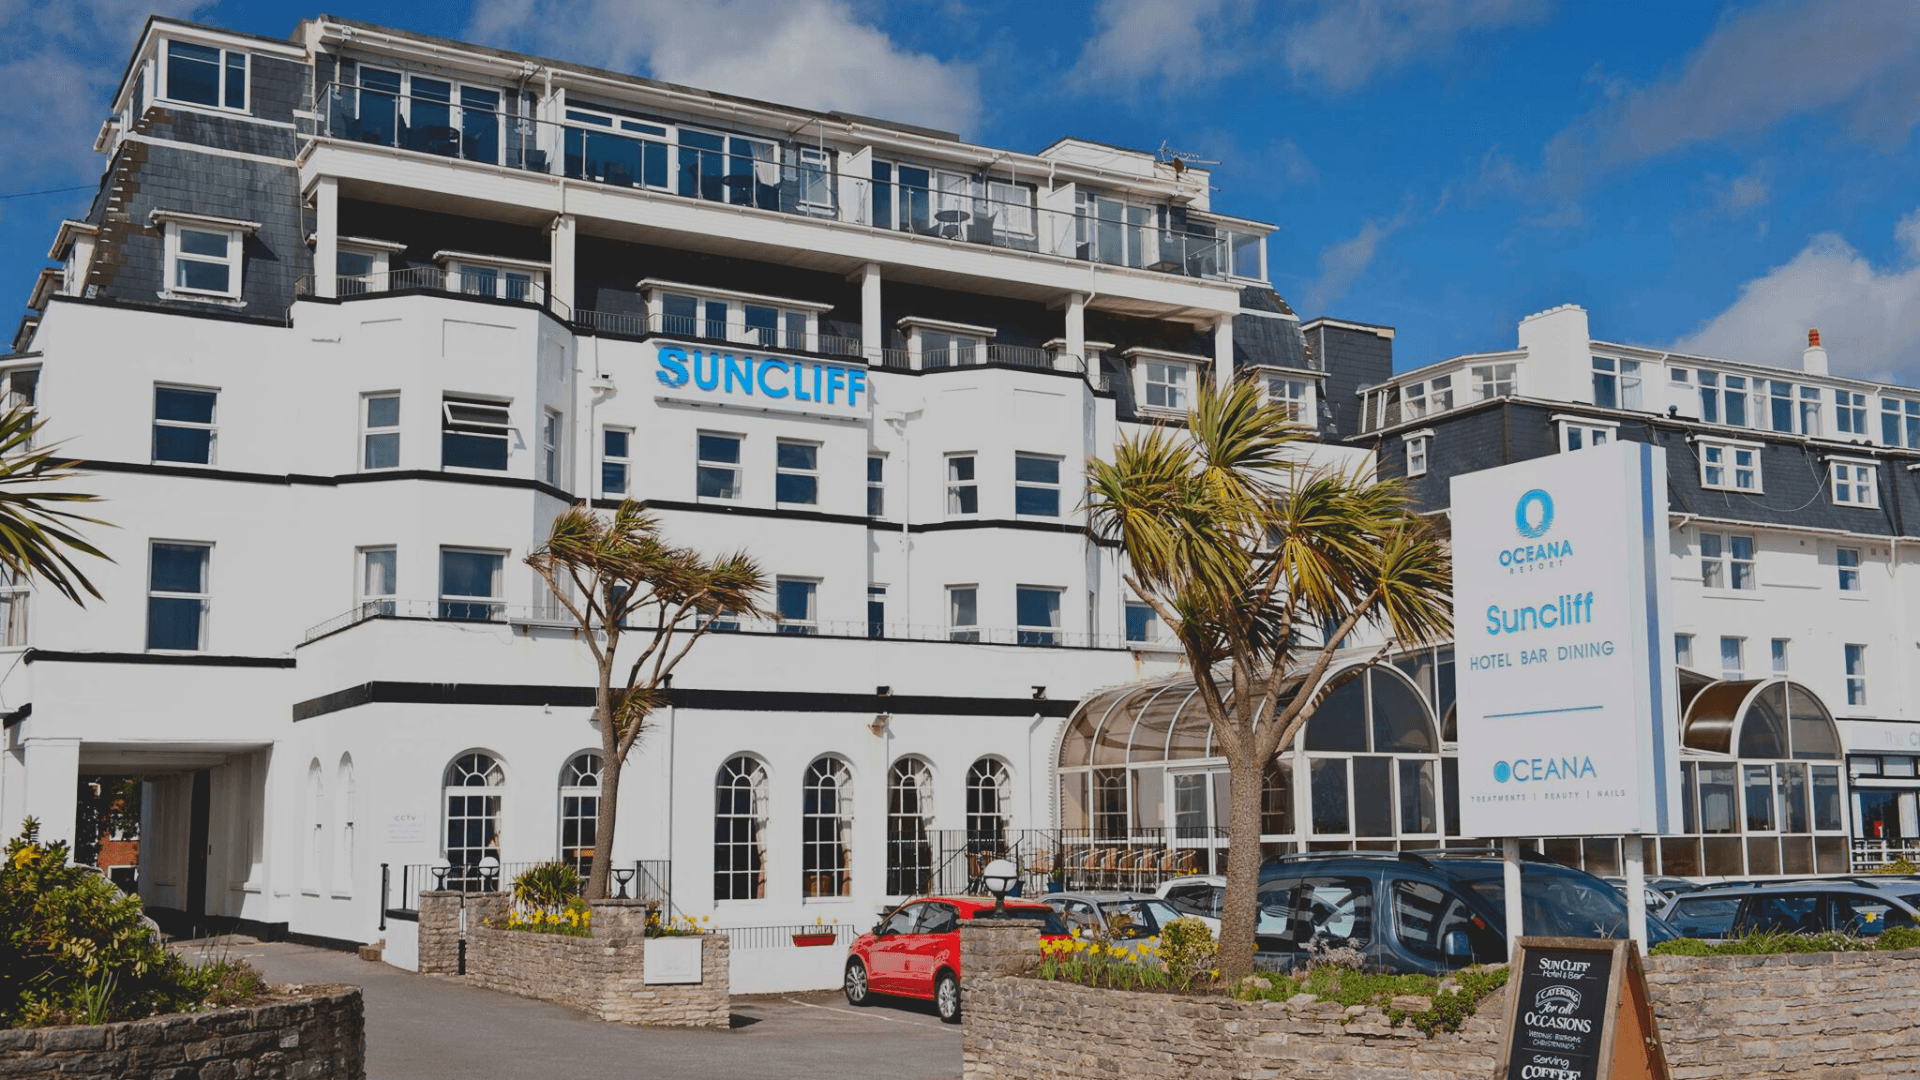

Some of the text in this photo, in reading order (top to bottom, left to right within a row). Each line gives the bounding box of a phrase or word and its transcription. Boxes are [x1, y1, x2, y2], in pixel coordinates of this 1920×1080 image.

[655, 346, 867, 406] SUNCLIFF
[1499, 540, 1573, 566] OCEANA
[1509, 560, 1563, 575] RESORT
[1486, 591, 1594, 635] Suncliff
[1470, 641, 1615, 670] HOTEL BAR DINING
[1471, 789, 1626, 803] TREATMENTS BEAUTY NAILS
[1542, 969, 1562, 979] Hotel
[1568, 972, 1586, 980] Bar
[1540, 987, 1579, 1002] CATERING
[1538, 1001, 1575, 1015] for all
[1524, 1011, 1592, 1033] OCCASIONS
[1521, 1065, 1581, 1080] COFFEE
